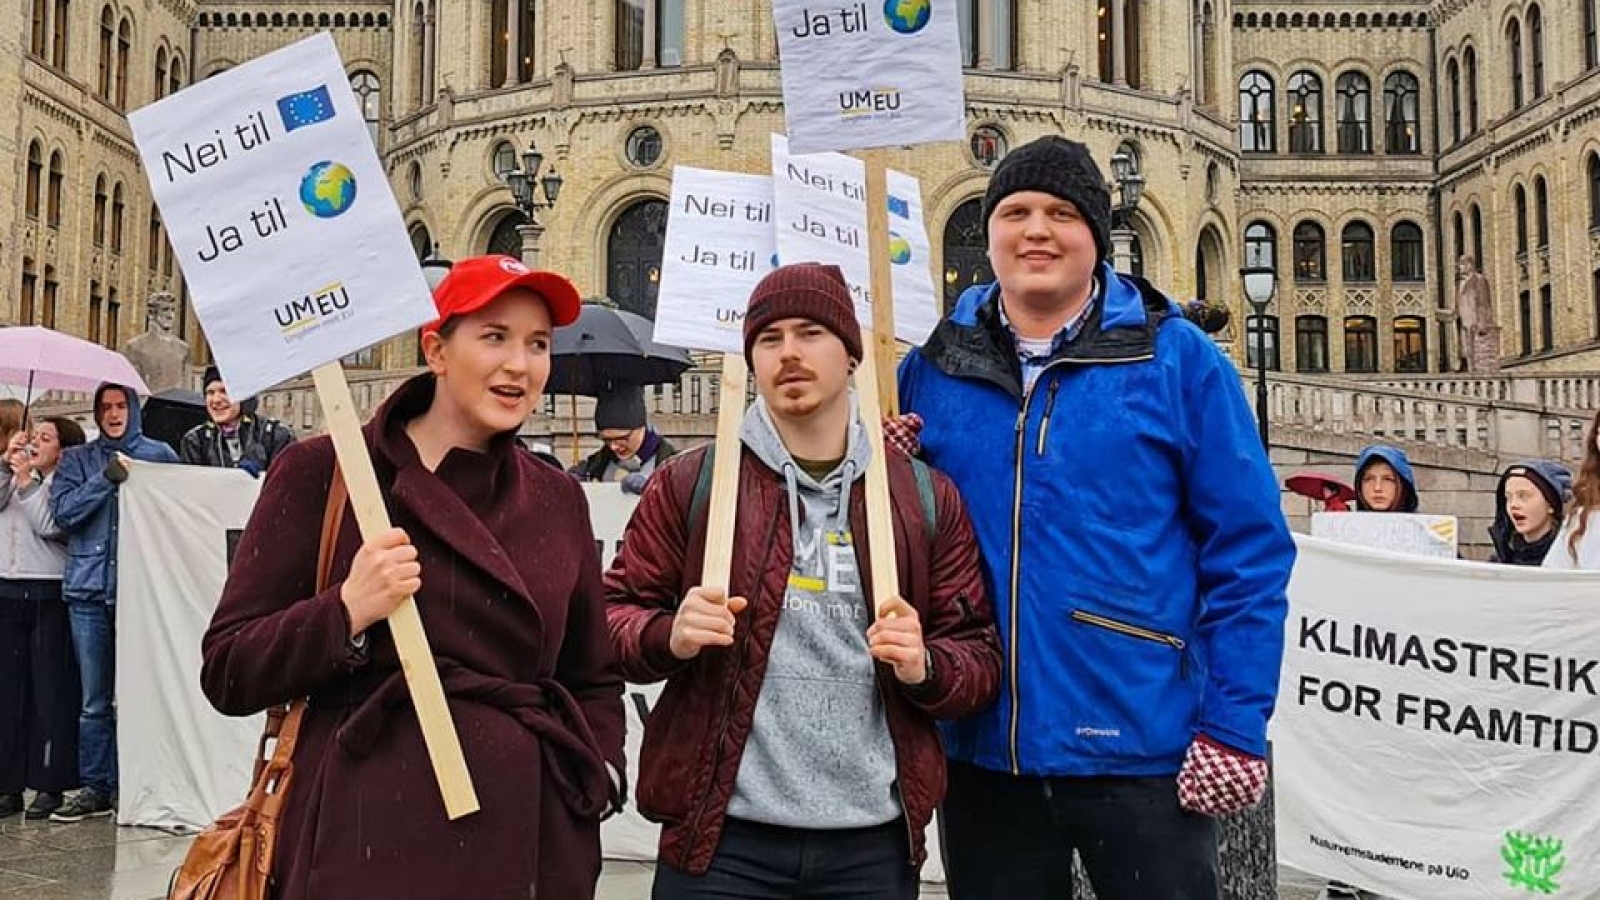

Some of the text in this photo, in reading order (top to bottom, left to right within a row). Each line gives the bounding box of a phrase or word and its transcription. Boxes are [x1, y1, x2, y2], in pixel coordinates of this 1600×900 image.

[793, 3, 868, 38] Ja til
[839, 90, 900, 111] UMEU
[162, 111, 271, 182] Nei til
[787, 163, 865, 201] Nei til
[684, 194, 770, 223] Nei til
[198, 198, 287, 262] Ja til
[792, 214, 859, 248] Ja til
[680, 245, 755, 271] Ja til
[274, 286, 350, 326] UMEU
[1298, 616, 1599, 695] KLIMASTREIK
[1298, 675, 1599, 753] FOR FRAMTID
